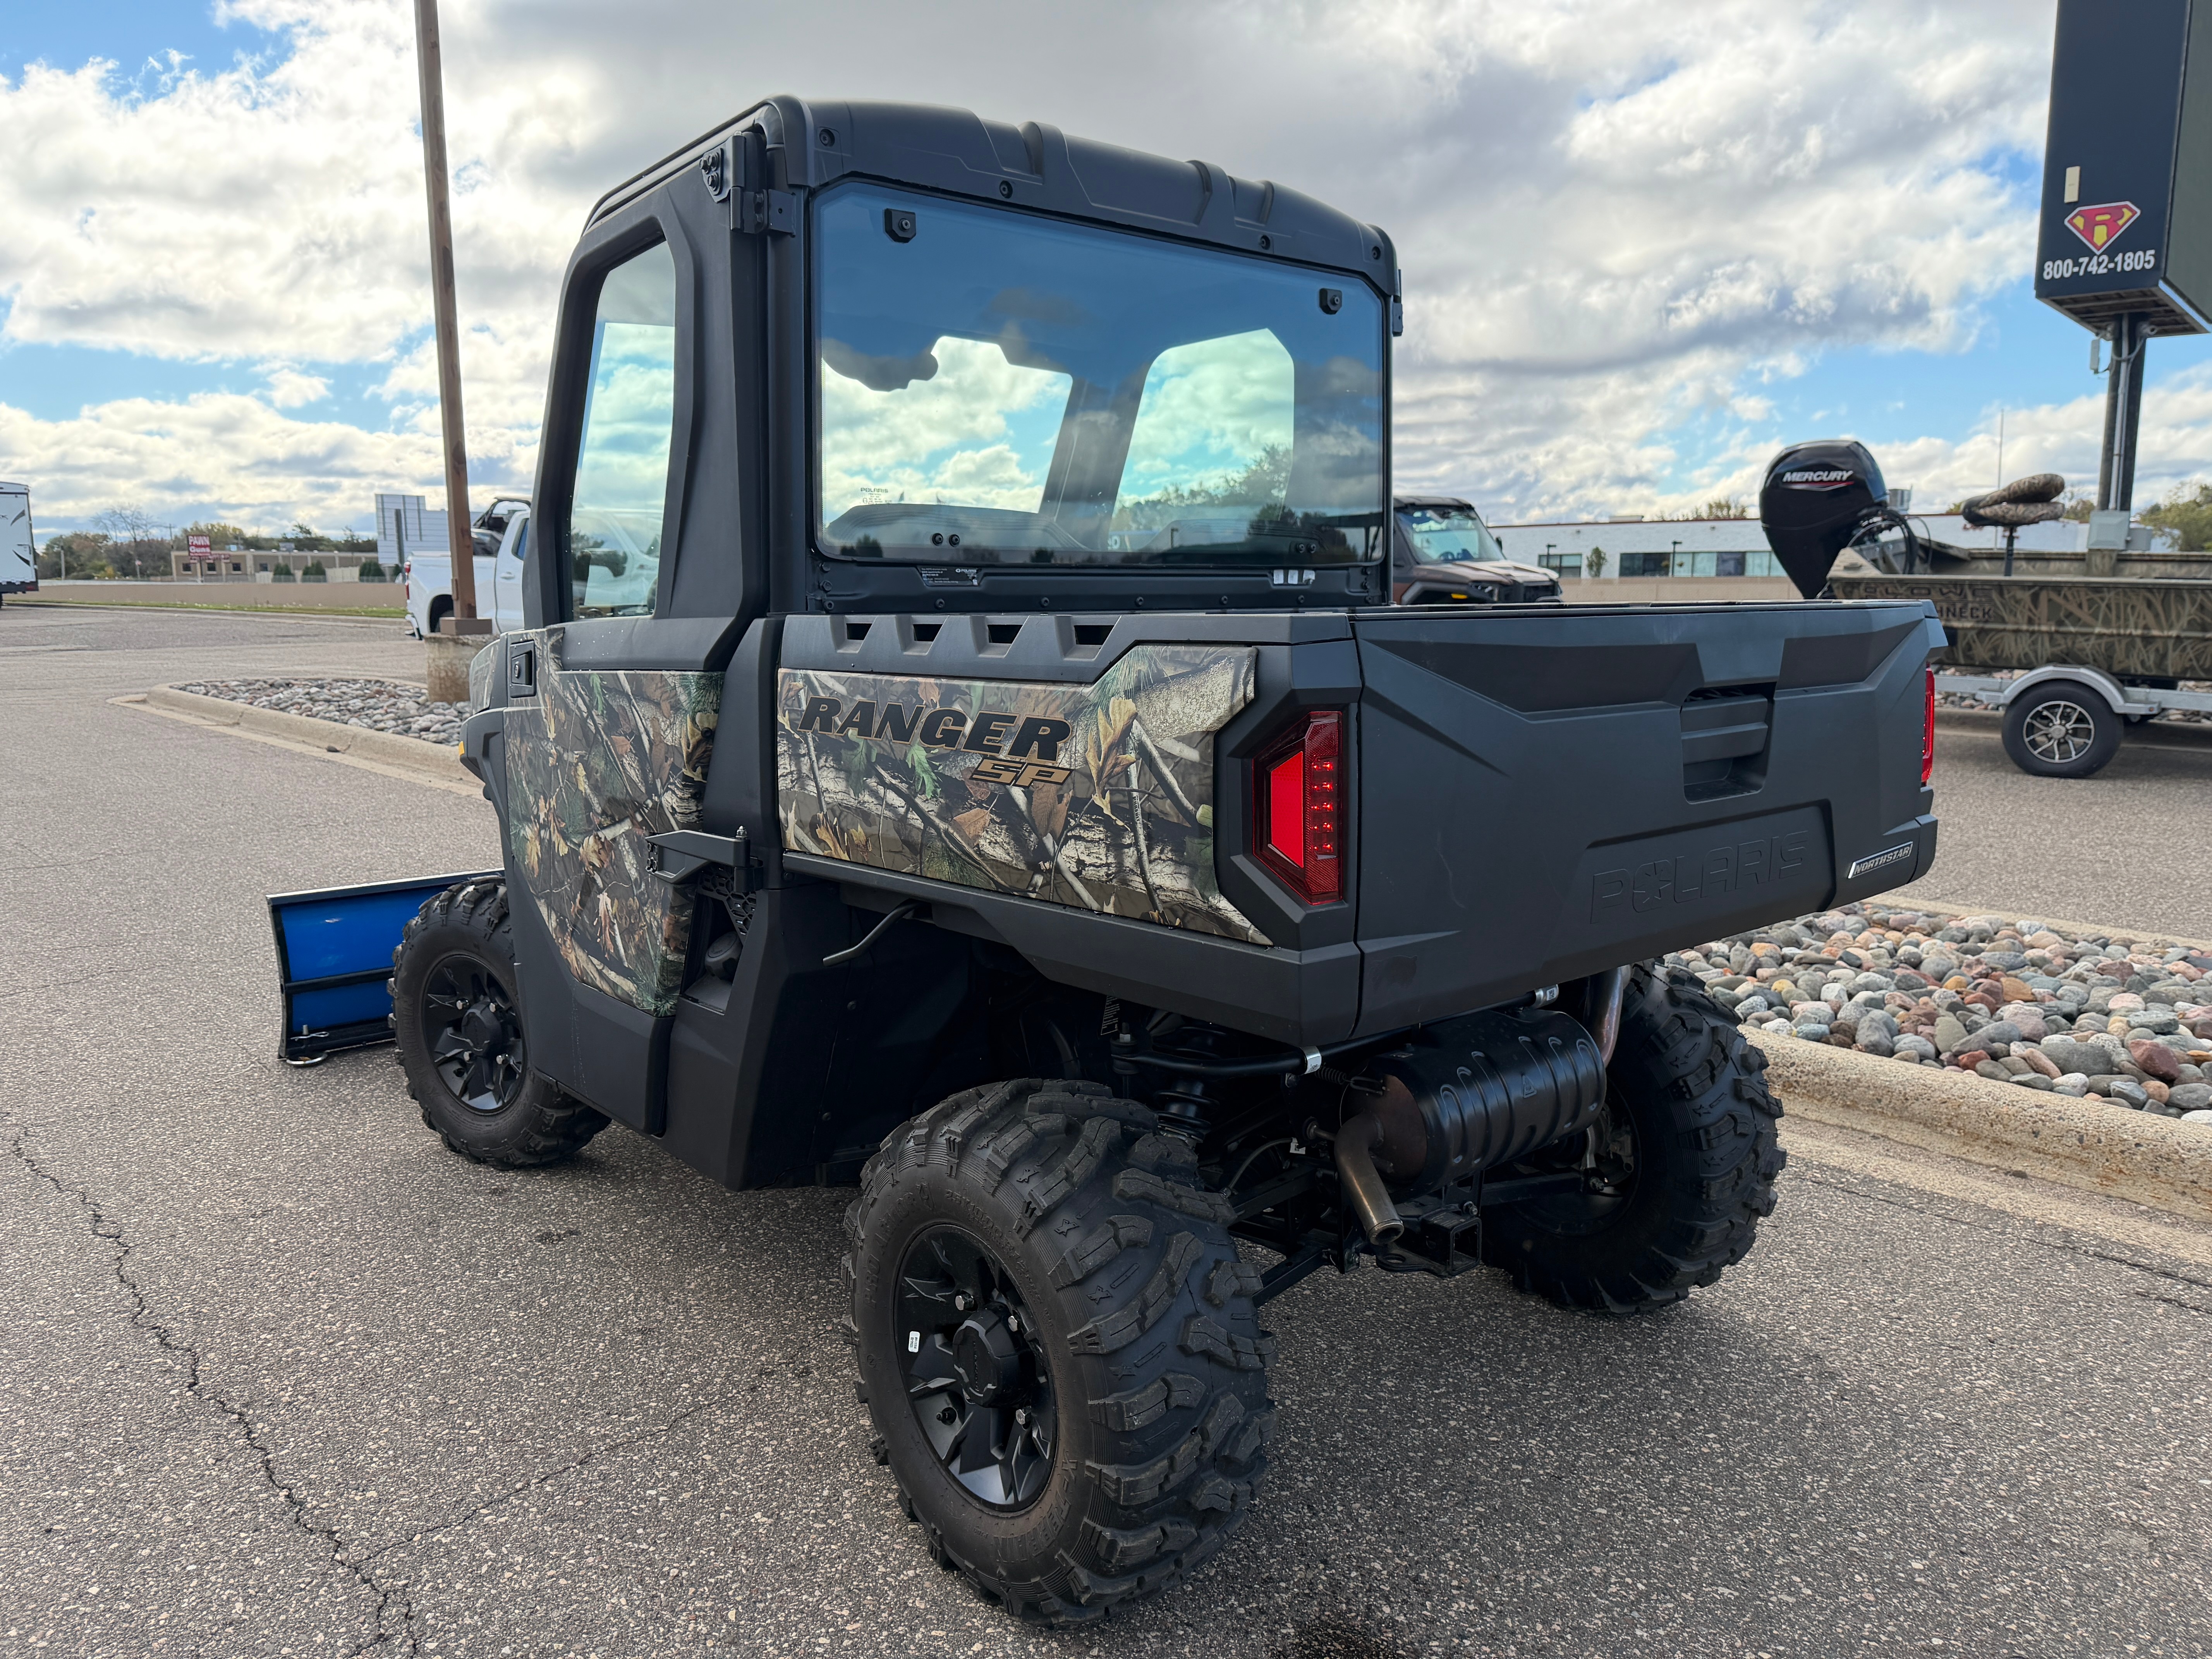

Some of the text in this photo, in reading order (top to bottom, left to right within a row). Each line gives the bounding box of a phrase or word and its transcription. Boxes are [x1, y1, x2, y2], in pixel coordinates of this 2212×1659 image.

[2043, 250, 2155, 280] 800-742-1805
[1783, 470, 1854, 482] MERCURY
[189, 536, 210, 545] PAWN
[798, 696, 1074, 762] RANGER
[970, 758, 1075, 788] SP
[1854, 846, 1910, 874] NORTHSTAR
[1590, 831, 1810, 925] POLARIS
[992, 1448, 1079, 1563] X-TERRAIN
